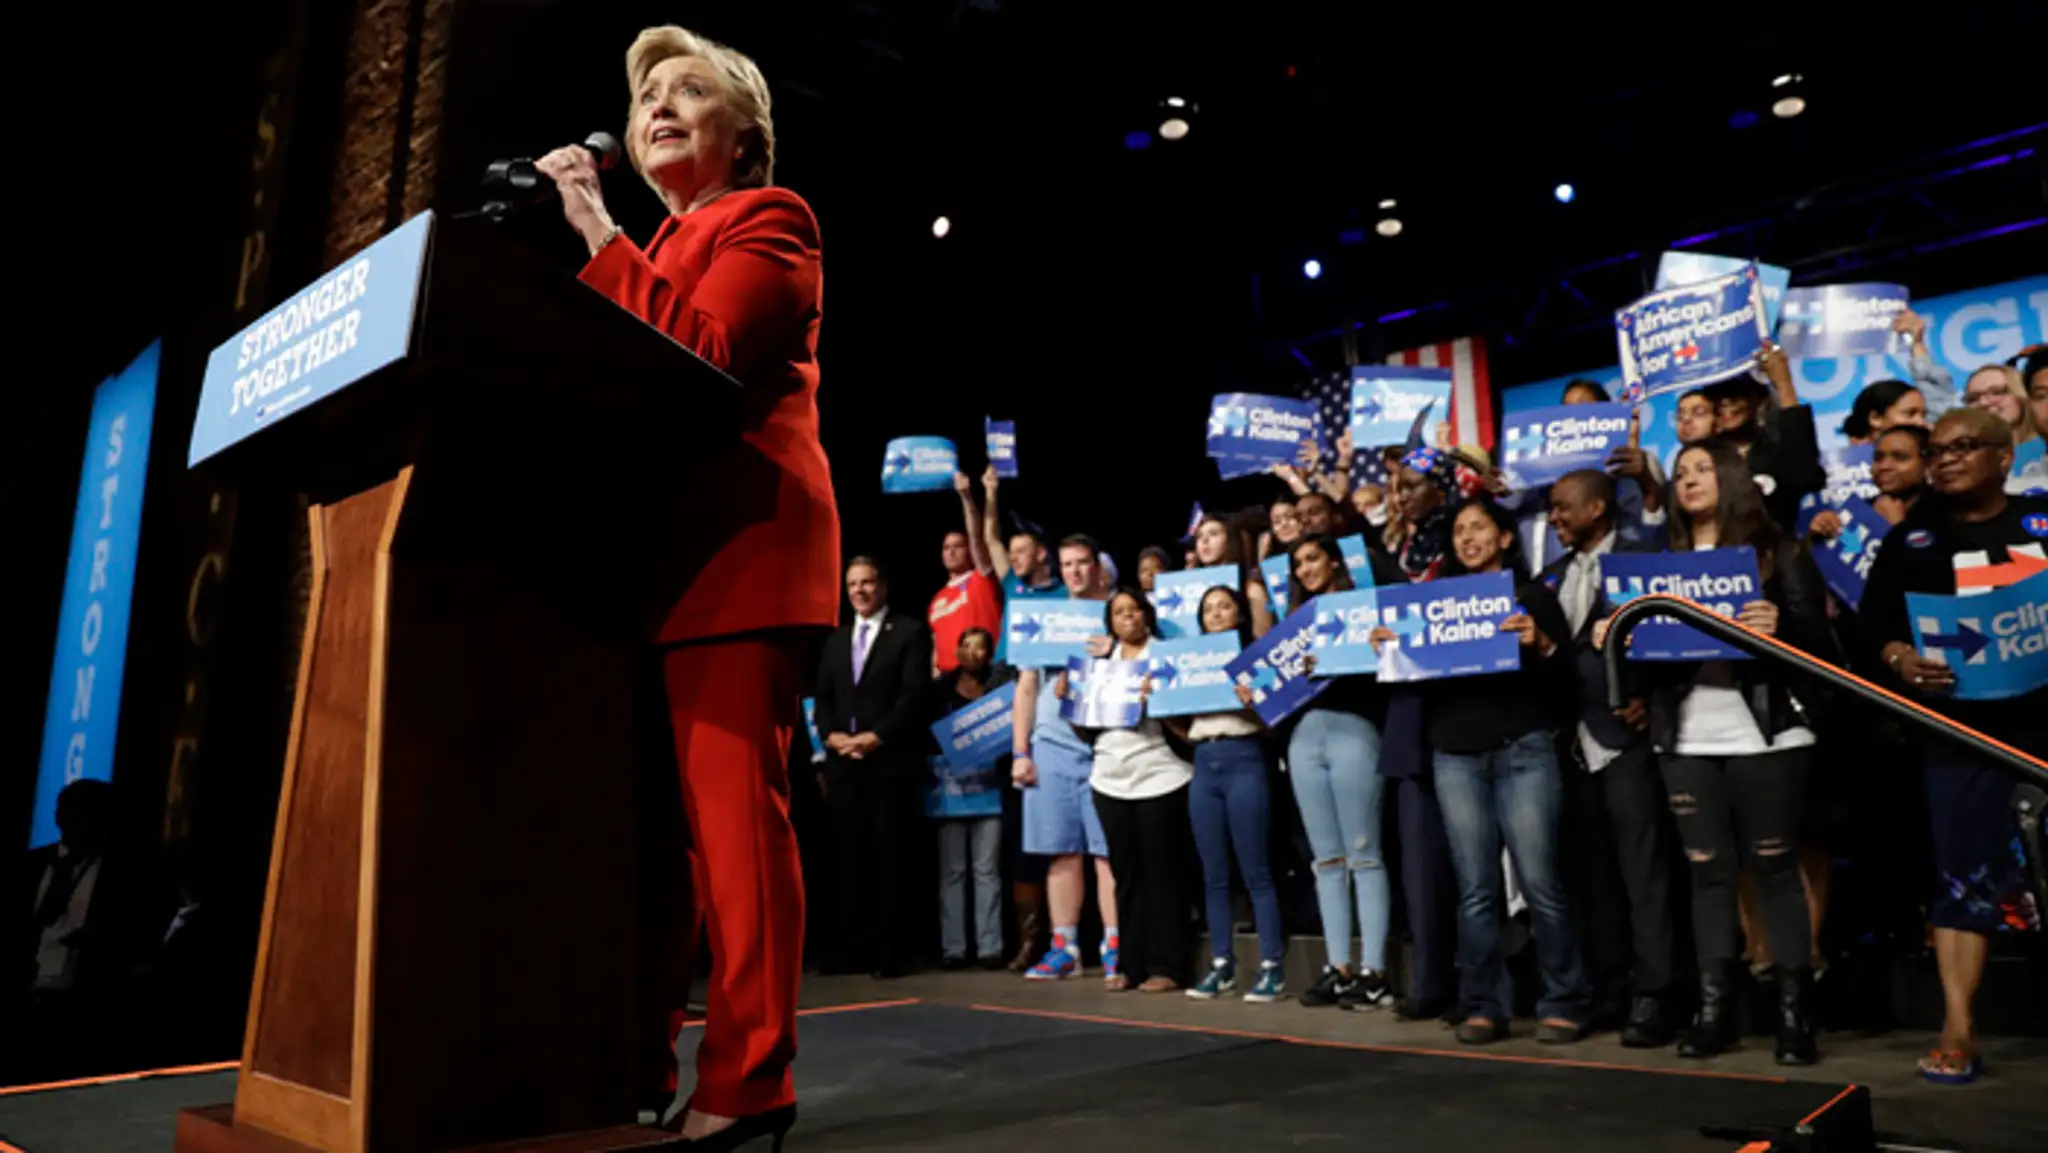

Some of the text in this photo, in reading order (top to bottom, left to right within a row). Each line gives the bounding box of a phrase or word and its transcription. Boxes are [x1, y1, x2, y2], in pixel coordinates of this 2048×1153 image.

[237, 257, 370, 371] STRONGER
[1637, 300, 1713, 338] African
[229, 308, 362, 417] TOGETHER
[1546, 415, 1627, 438] Clinton
[1546, 434, 1609, 457] Kaine
[64, 413, 127, 785] STRONG
[1649, 572, 1754, 598] Clinton
[1426, 594, 1512, 622] Clinton
[1429, 618, 1497, 646] Kaine
